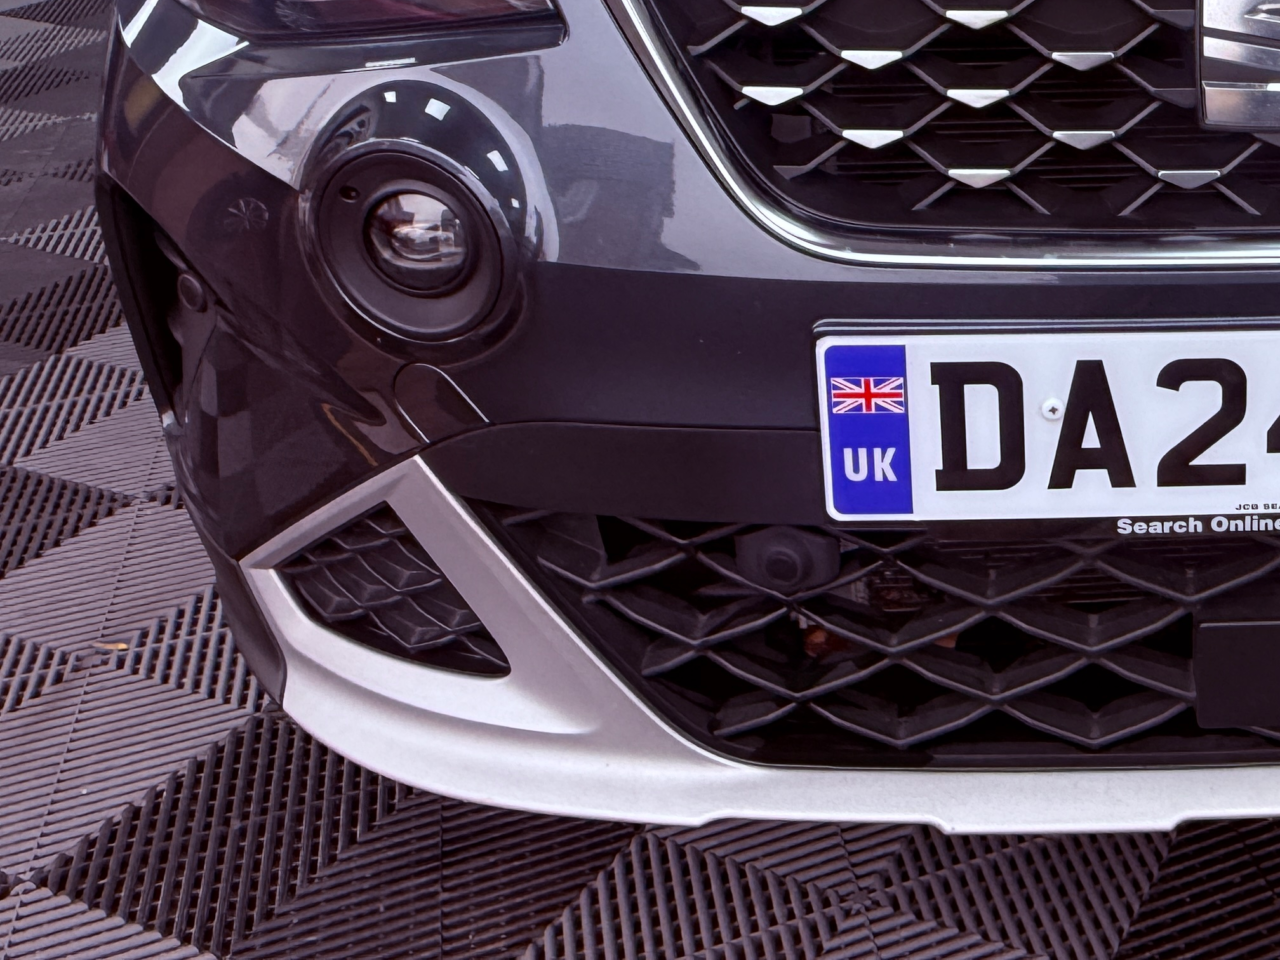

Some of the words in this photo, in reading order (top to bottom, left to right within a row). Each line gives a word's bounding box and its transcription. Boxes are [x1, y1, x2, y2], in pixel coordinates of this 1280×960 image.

[843, 448, 897, 481] UK
[1235, 503, 1259, 511] JCB
[1117, 517, 1203, 534] Search
